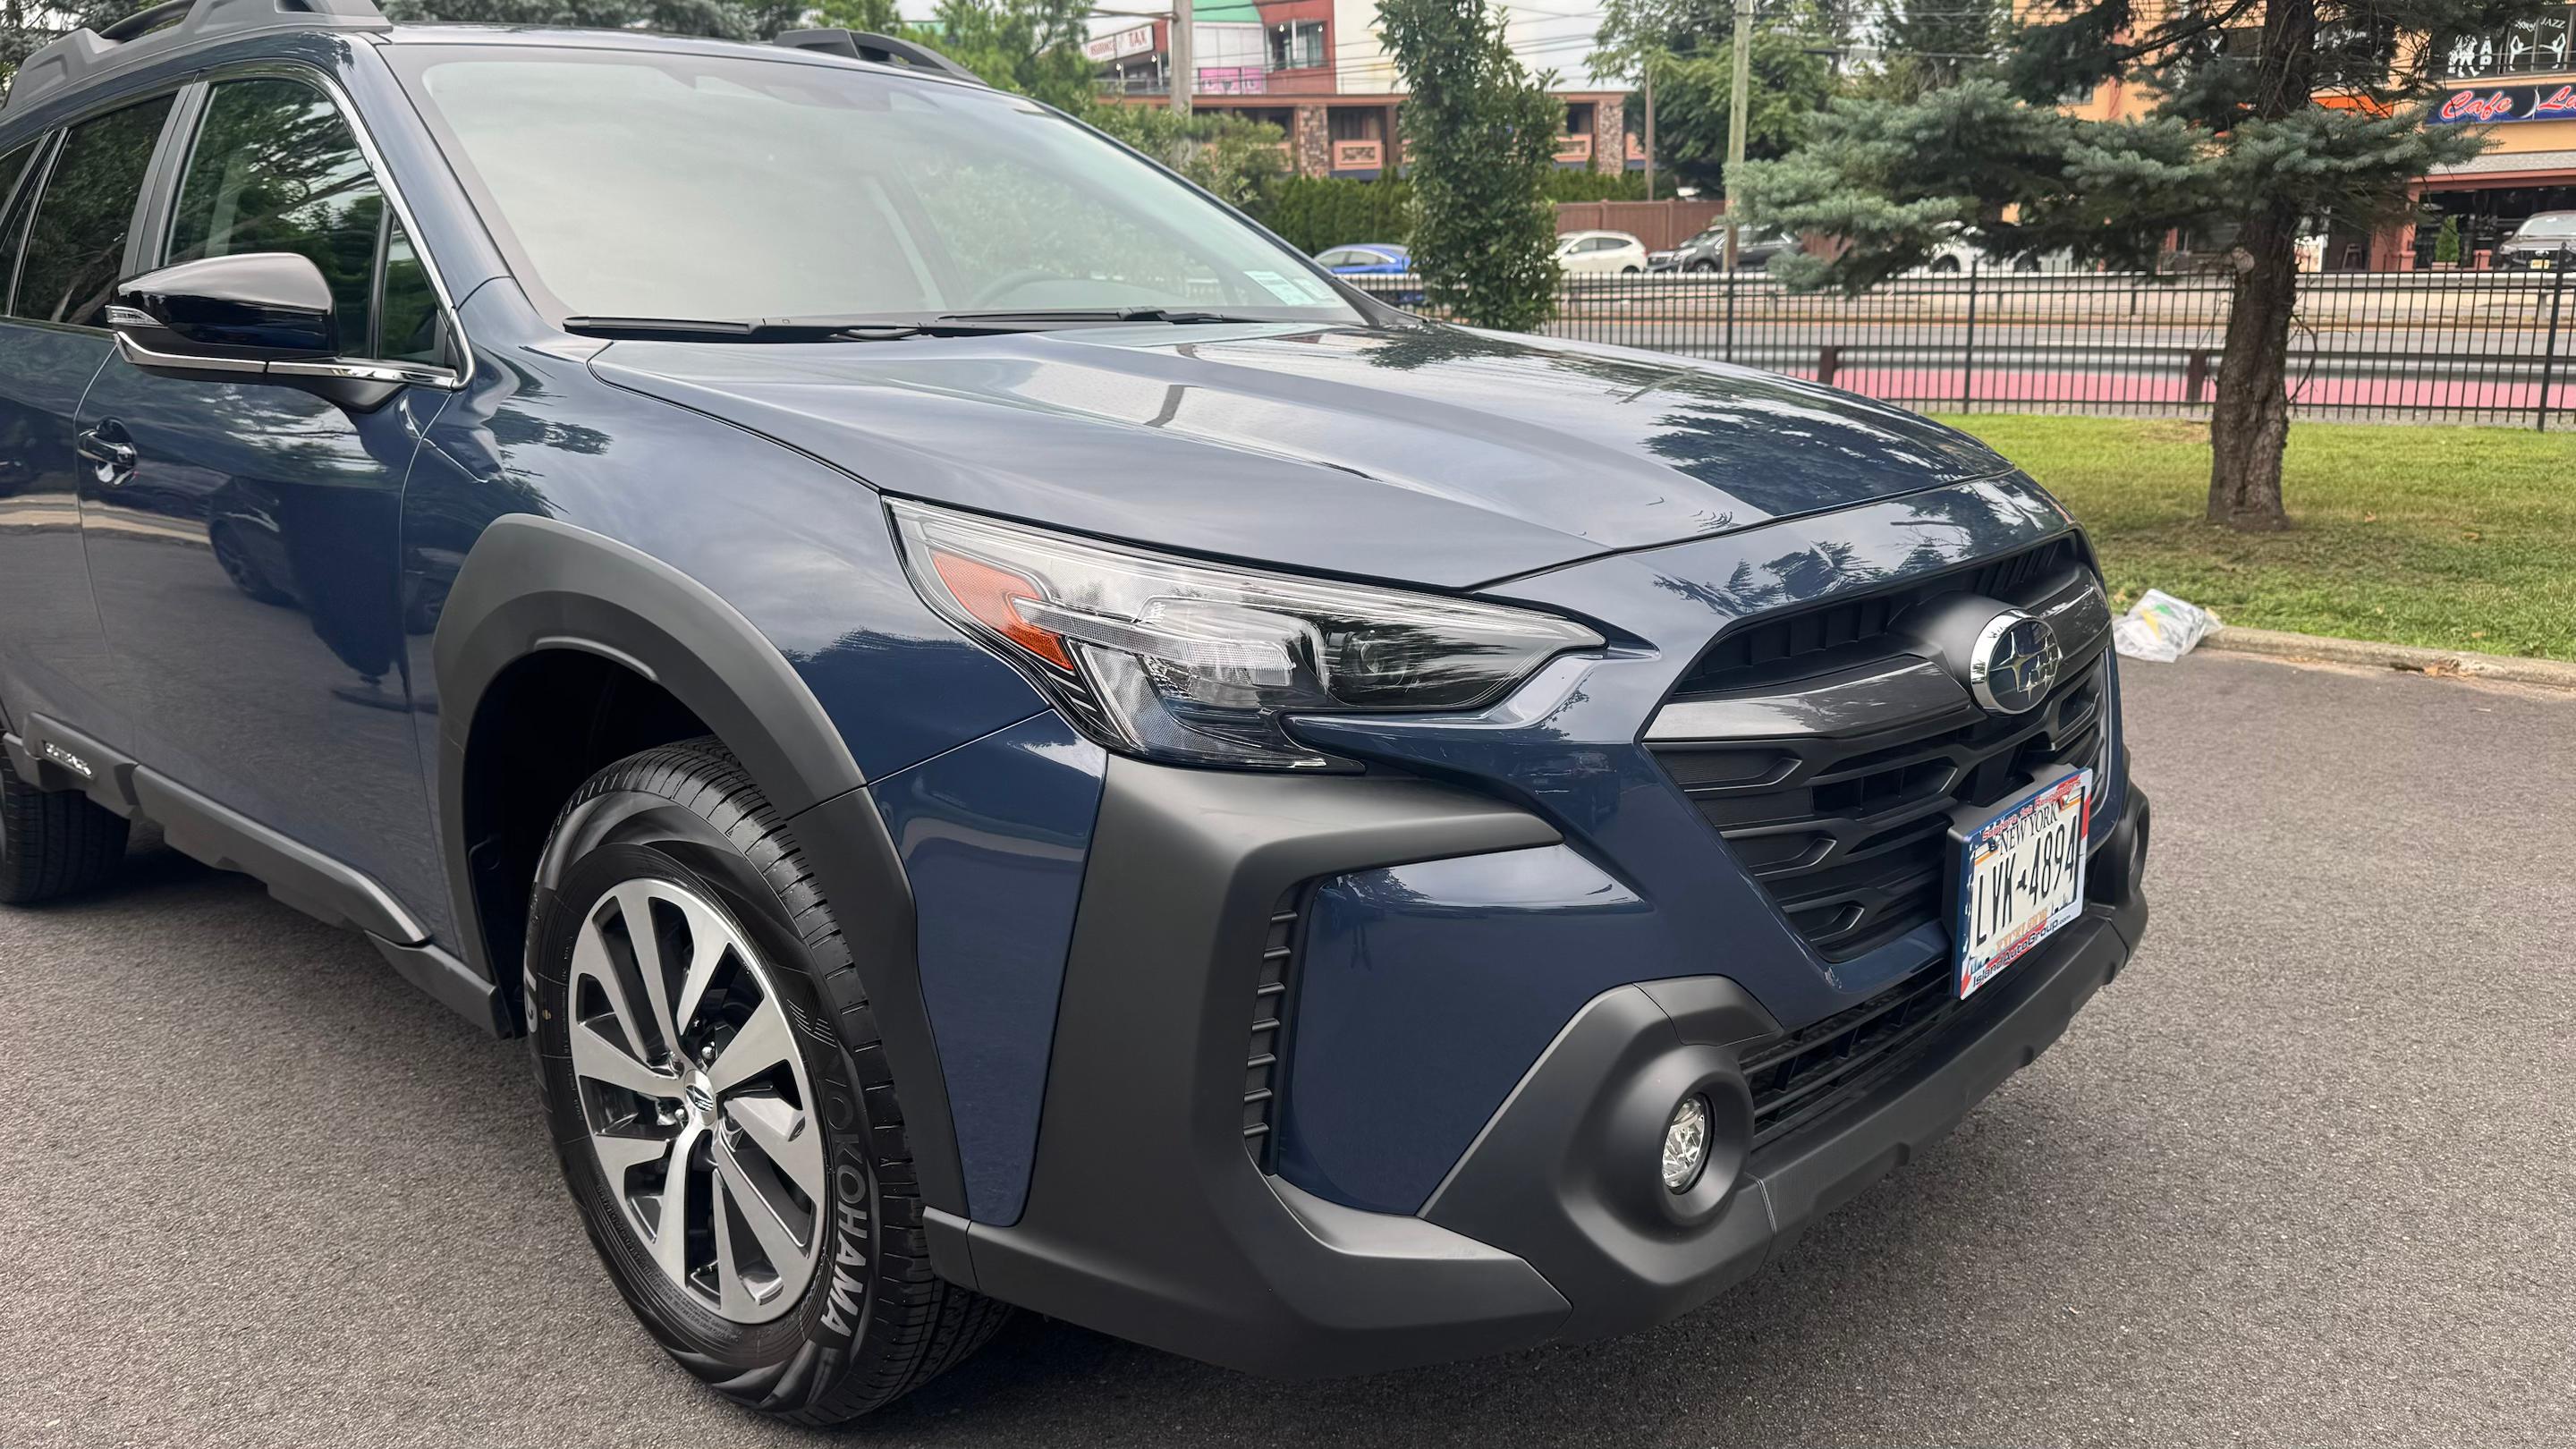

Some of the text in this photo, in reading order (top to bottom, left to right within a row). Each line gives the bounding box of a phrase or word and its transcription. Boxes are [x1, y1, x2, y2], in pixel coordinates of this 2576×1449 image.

[1129, 28, 1148, 47] TAX
[2540, 16, 2566, 29] JAZZ
[2000, 801, 2058, 855] NEW YORK
[1977, 815, 2077, 947] LVK 4894
